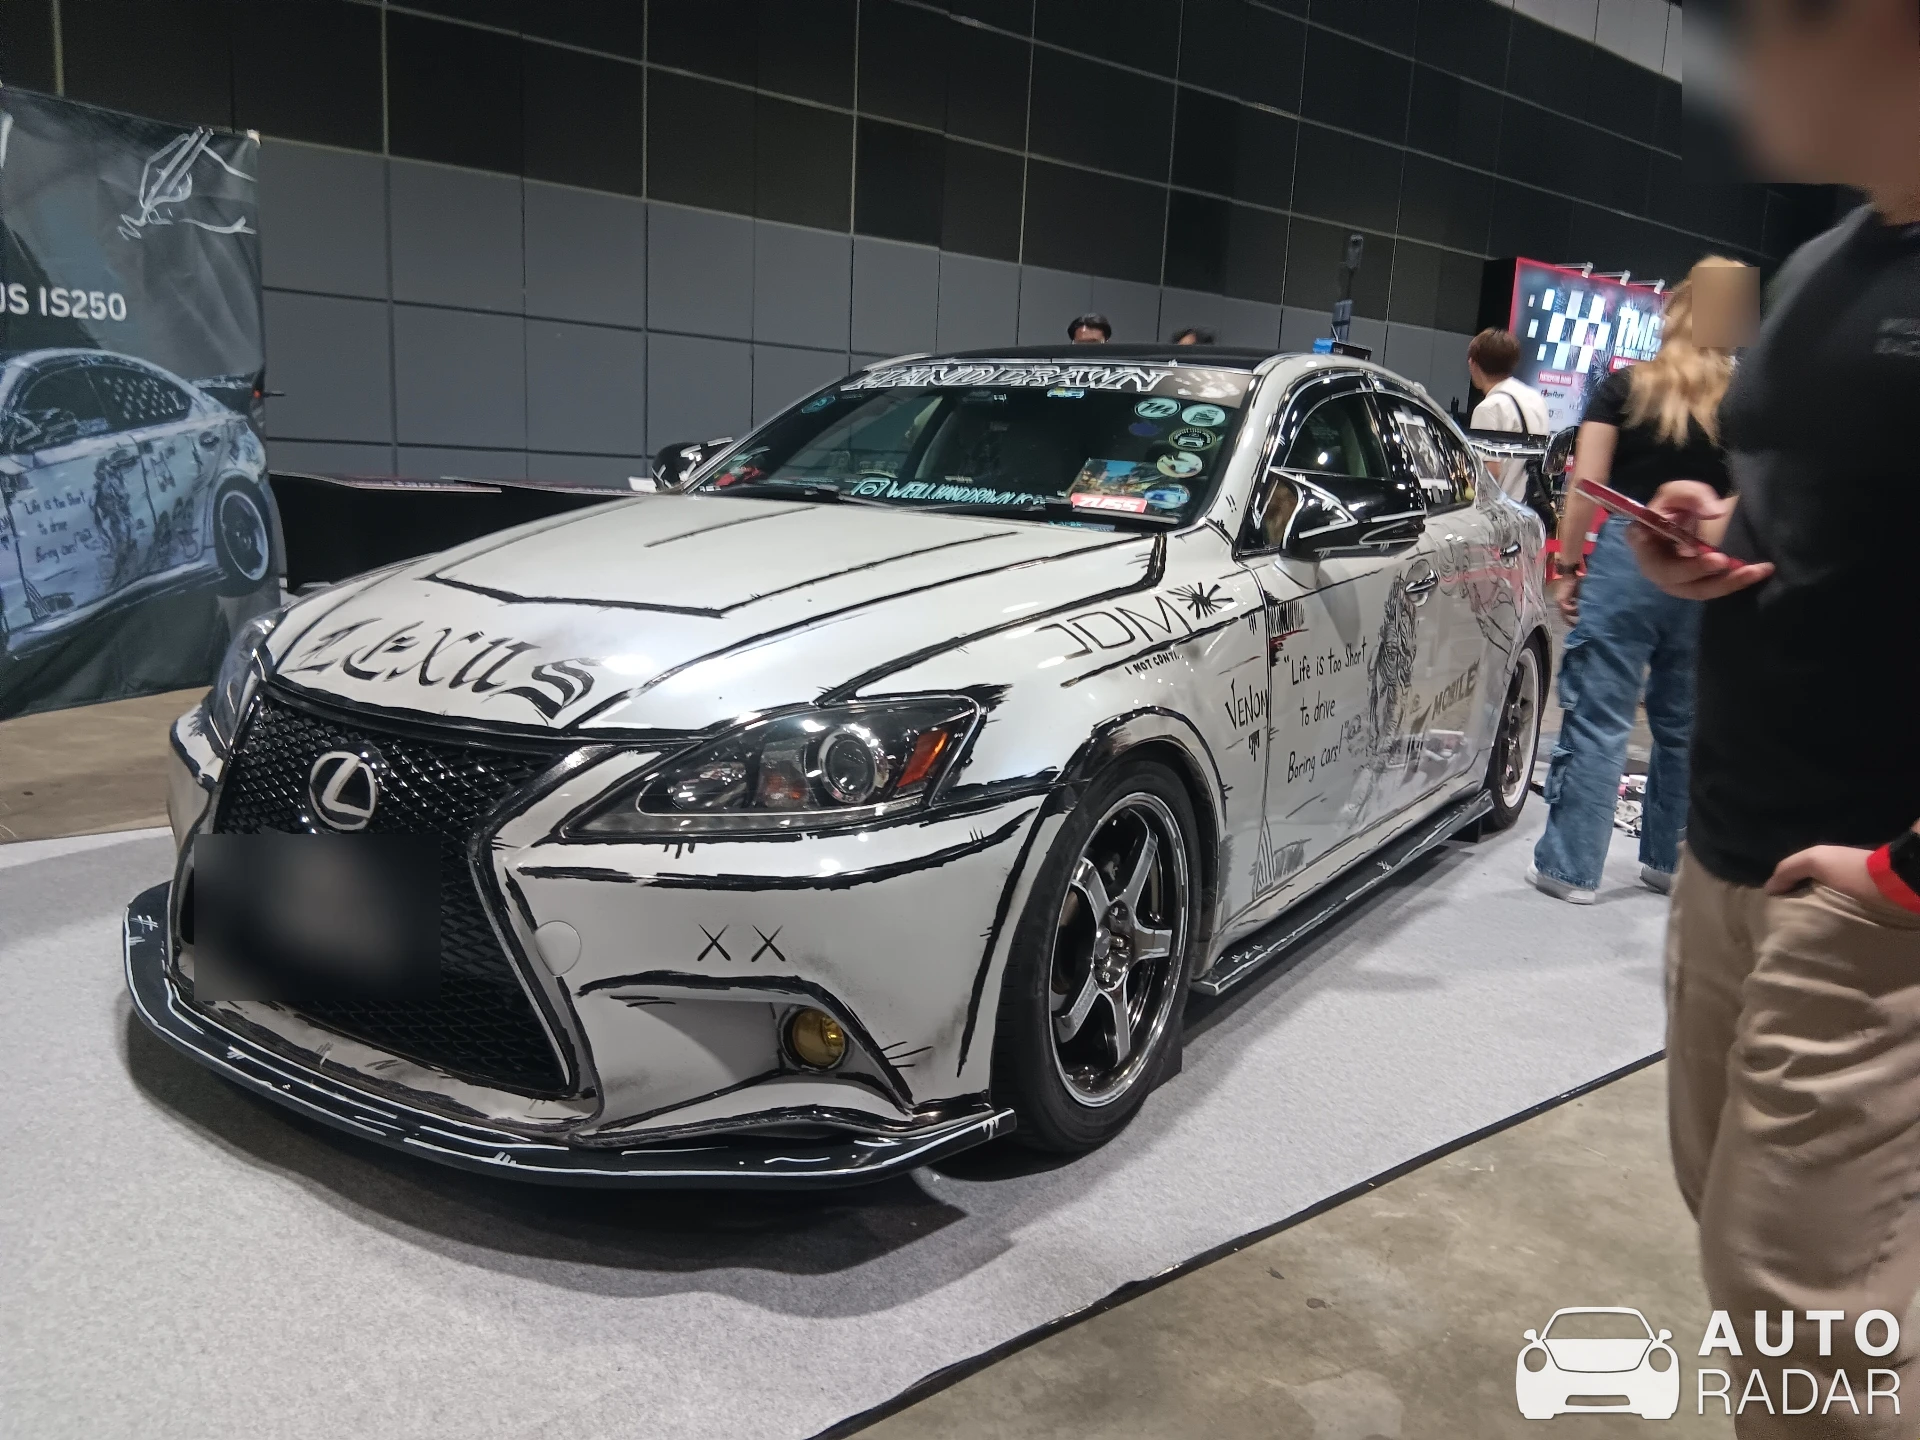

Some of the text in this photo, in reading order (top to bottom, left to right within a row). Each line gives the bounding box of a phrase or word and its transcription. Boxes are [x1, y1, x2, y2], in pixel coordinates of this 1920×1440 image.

[0, 281, 127, 322] S IS250
[1034, 596, 1194, 660] JDM
[1132, 658, 1153, 674] NOT
[1316, 655, 1325, 677] is
[1327, 647, 1342, 675] too
[1224, 677, 1269, 730] VENOM
[1313, 690, 1336, 722] drive
[1287, 750, 1316, 783] Boring
